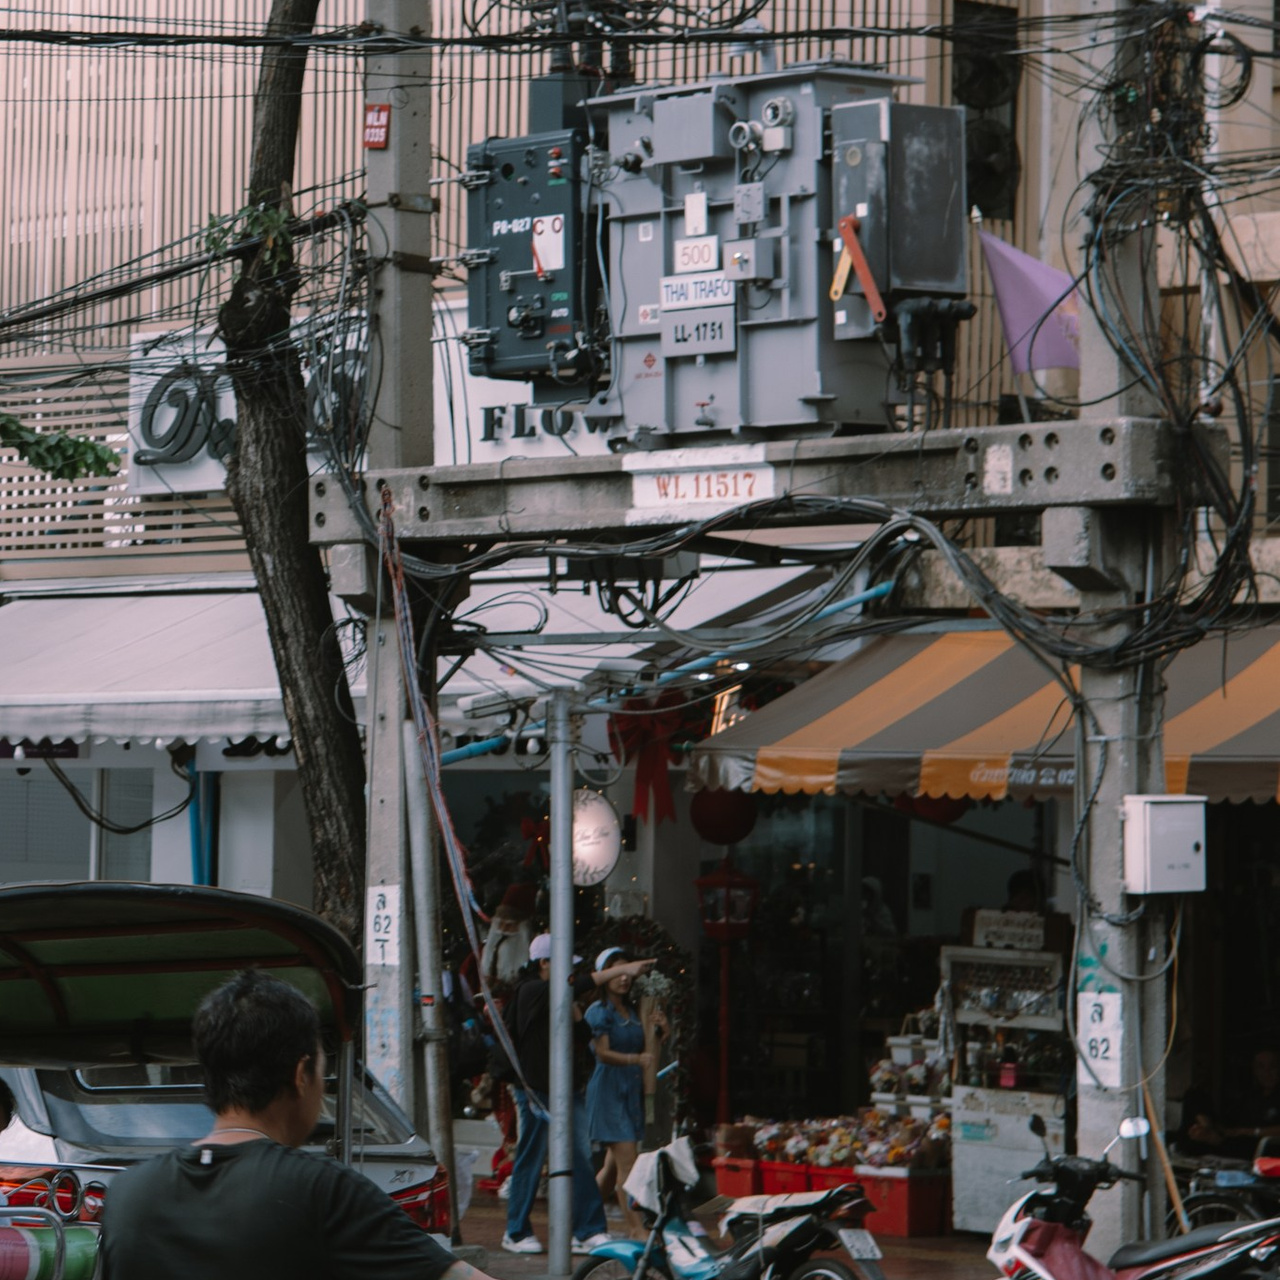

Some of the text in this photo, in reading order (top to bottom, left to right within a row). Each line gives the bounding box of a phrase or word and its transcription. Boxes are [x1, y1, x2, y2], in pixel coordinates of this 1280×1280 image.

[681, 243, 712, 266] 500
[663, 278, 732, 303] THAI TRAFO
[551, 307, 569, 318] AUTO
[655, 472, 756, 500] WL 11517
[373, 914, 392, 934] 62
[1089, 1038, 1110, 1060] 62
